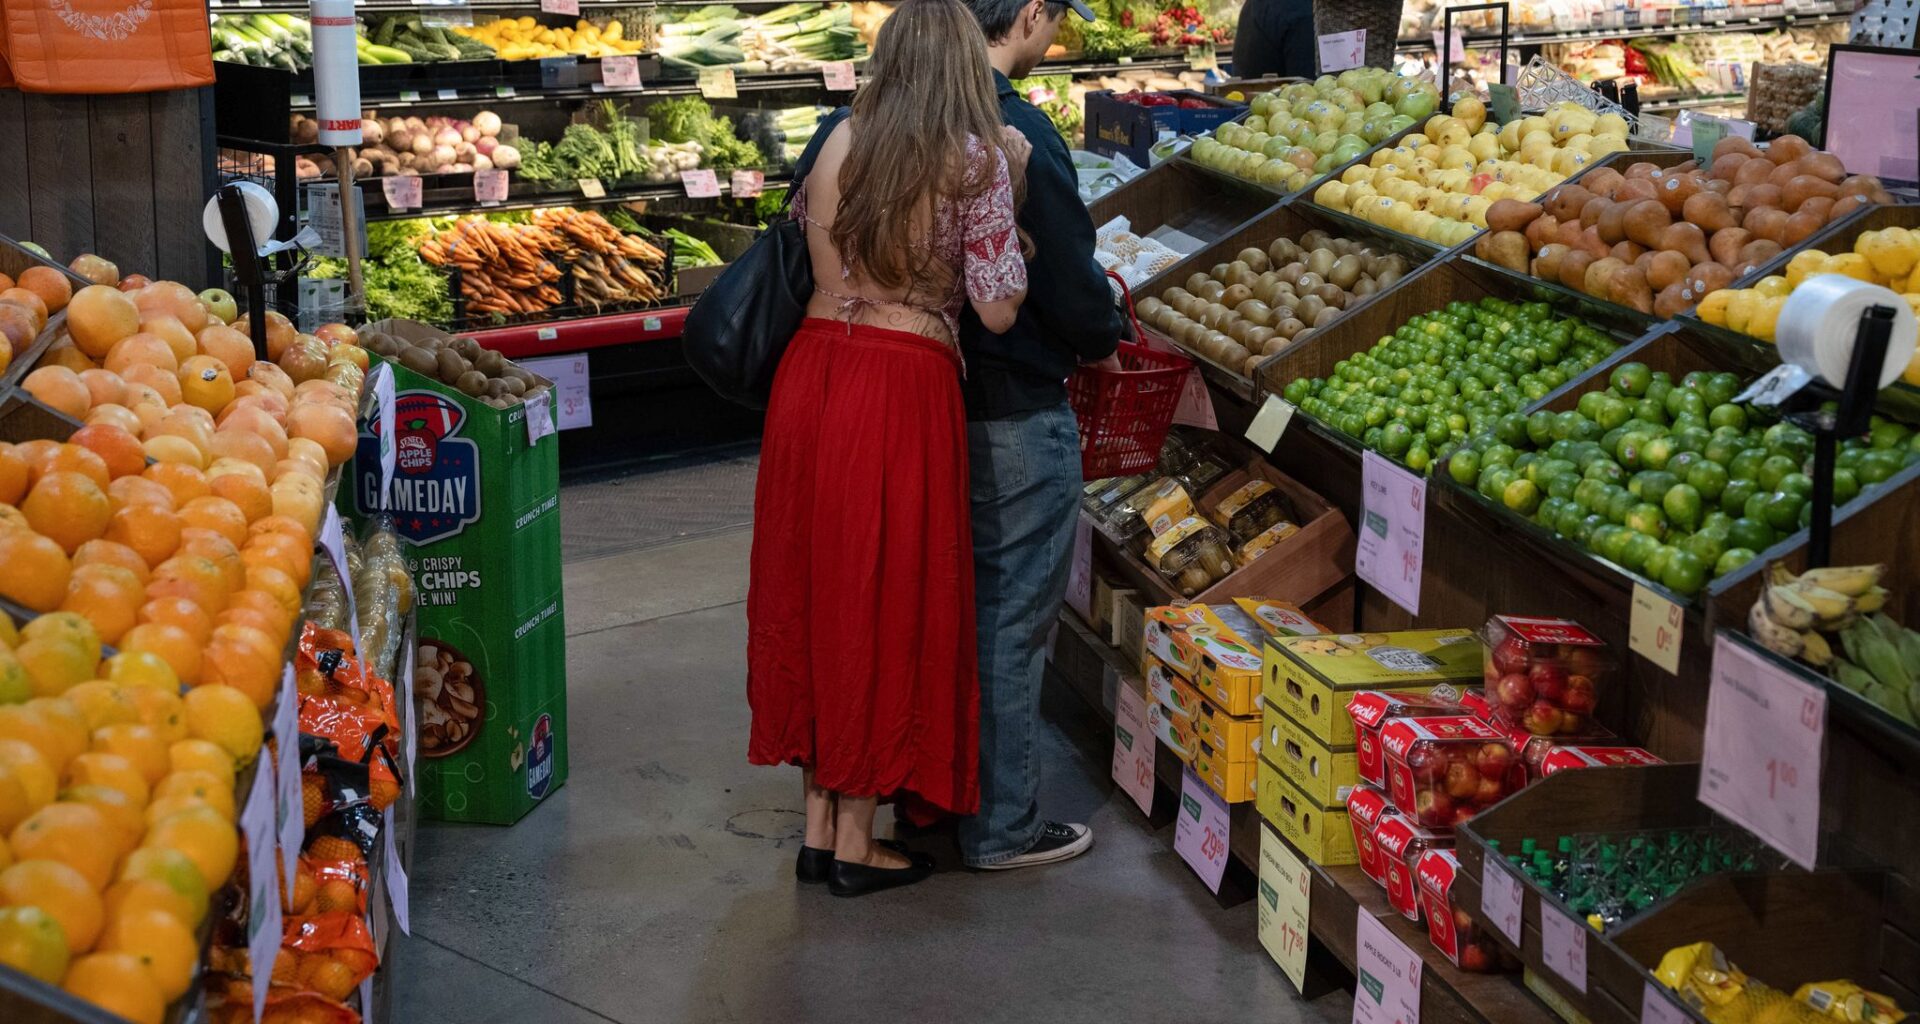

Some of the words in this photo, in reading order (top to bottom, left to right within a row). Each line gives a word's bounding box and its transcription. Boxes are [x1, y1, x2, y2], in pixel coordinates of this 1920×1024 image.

[399, 448, 432, 459] APPLE
[401, 458, 432, 468] CHIPS
[364, 472, 466, 514] GAMEDAY
[515, 511, 540, 529] CRUNCH
[541, 494, 557, 514] TIME!
[409, 559, 418, 571] &
[423, 556, 462, 571] CRISPY
[421, 570, 481, 590] CHIPS
[431, 591, 457, 605] WIN!
[514, 618, 540, 639] CRUNCH
[540, 601, 557, 619] TIME!
